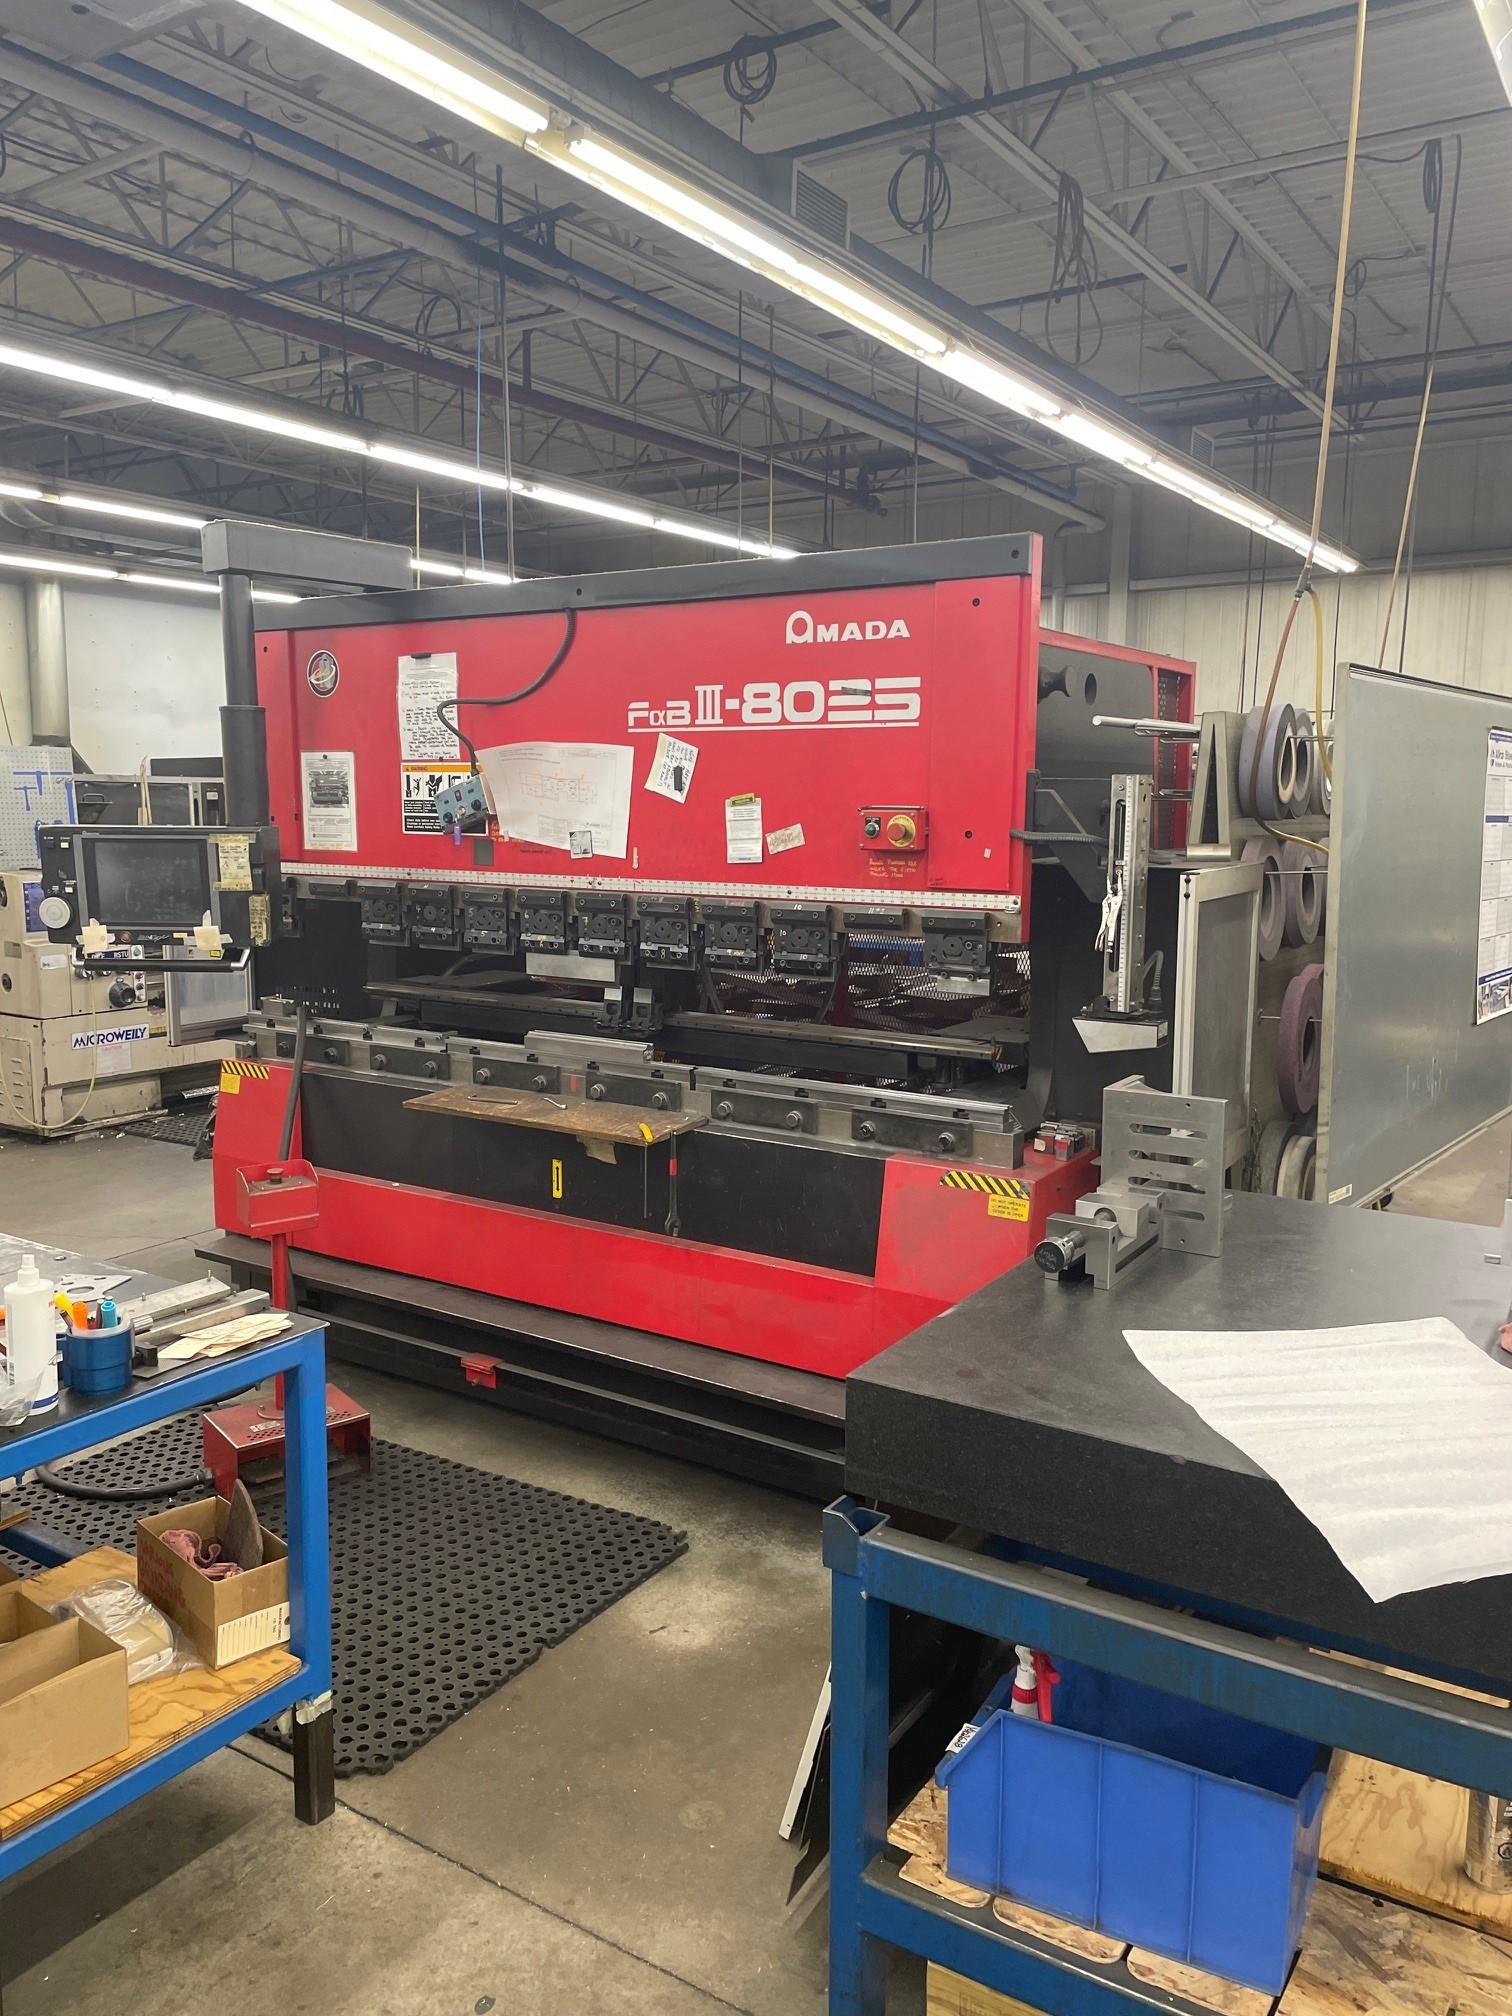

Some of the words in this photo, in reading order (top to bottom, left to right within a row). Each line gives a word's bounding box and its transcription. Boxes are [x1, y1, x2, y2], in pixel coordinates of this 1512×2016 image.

[785, 610, 910, 644] AMADA
[661, 948, 666, 959] 8
[73, 1027, 147, 1048] MICROWEILY
[1008, 1200, 1026, 1208] OPERATE
